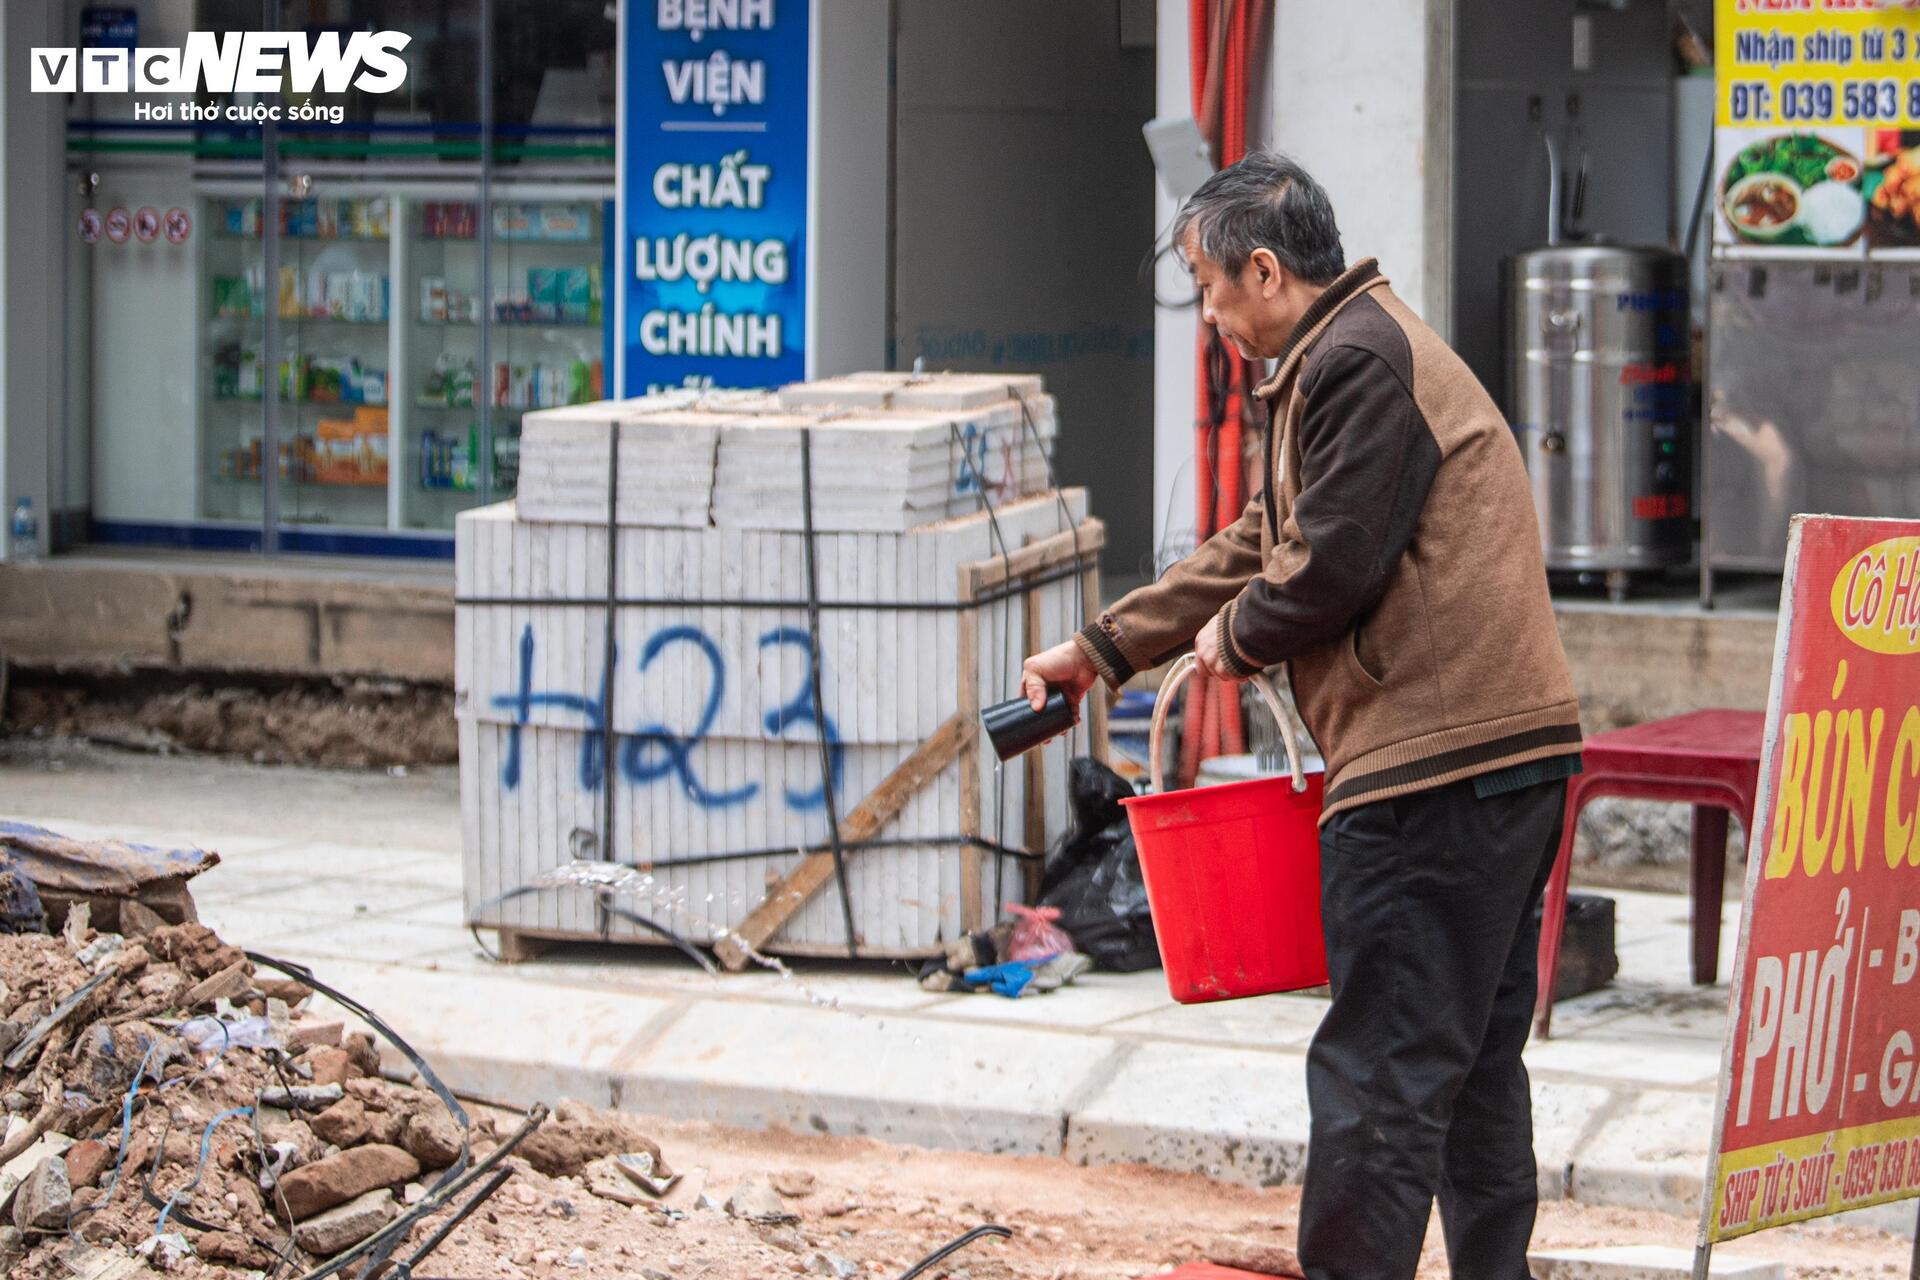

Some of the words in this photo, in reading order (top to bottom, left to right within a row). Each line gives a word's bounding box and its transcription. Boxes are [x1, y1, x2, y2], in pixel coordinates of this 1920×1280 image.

[1735, 29, 1796, 70] Nhận
[1803, 29, 1853, 65] ship
[1892, 28, 1906, 60] 3
[661, 49, 766, 116] VIỆN
[1731, 82, 1772, 120] ĐT:
[1782, 81, 1833, 120] 039
[1843, 81, 1897, 120] 583
[653, 148, 771, 209] CHẤT
[635, 232, 788, 294] LƯỢNG
[639, 301, 782, 359] CHÍNH
[1844, 553, 1887, 628] Cô
[1764, 659, 1884, 879] BÚN
[1736, 886, 1854, 1127] PHỞ
[1718, 1168, 1761, 1229] SHIP
[1759, 1151, 1787, 1218] TỪ
[1780, 1161, 1795, 1214] 3
[1793, 1134, 1836, 1211] SUẤT
[1842, 1144, 1881, 1201] 0395
